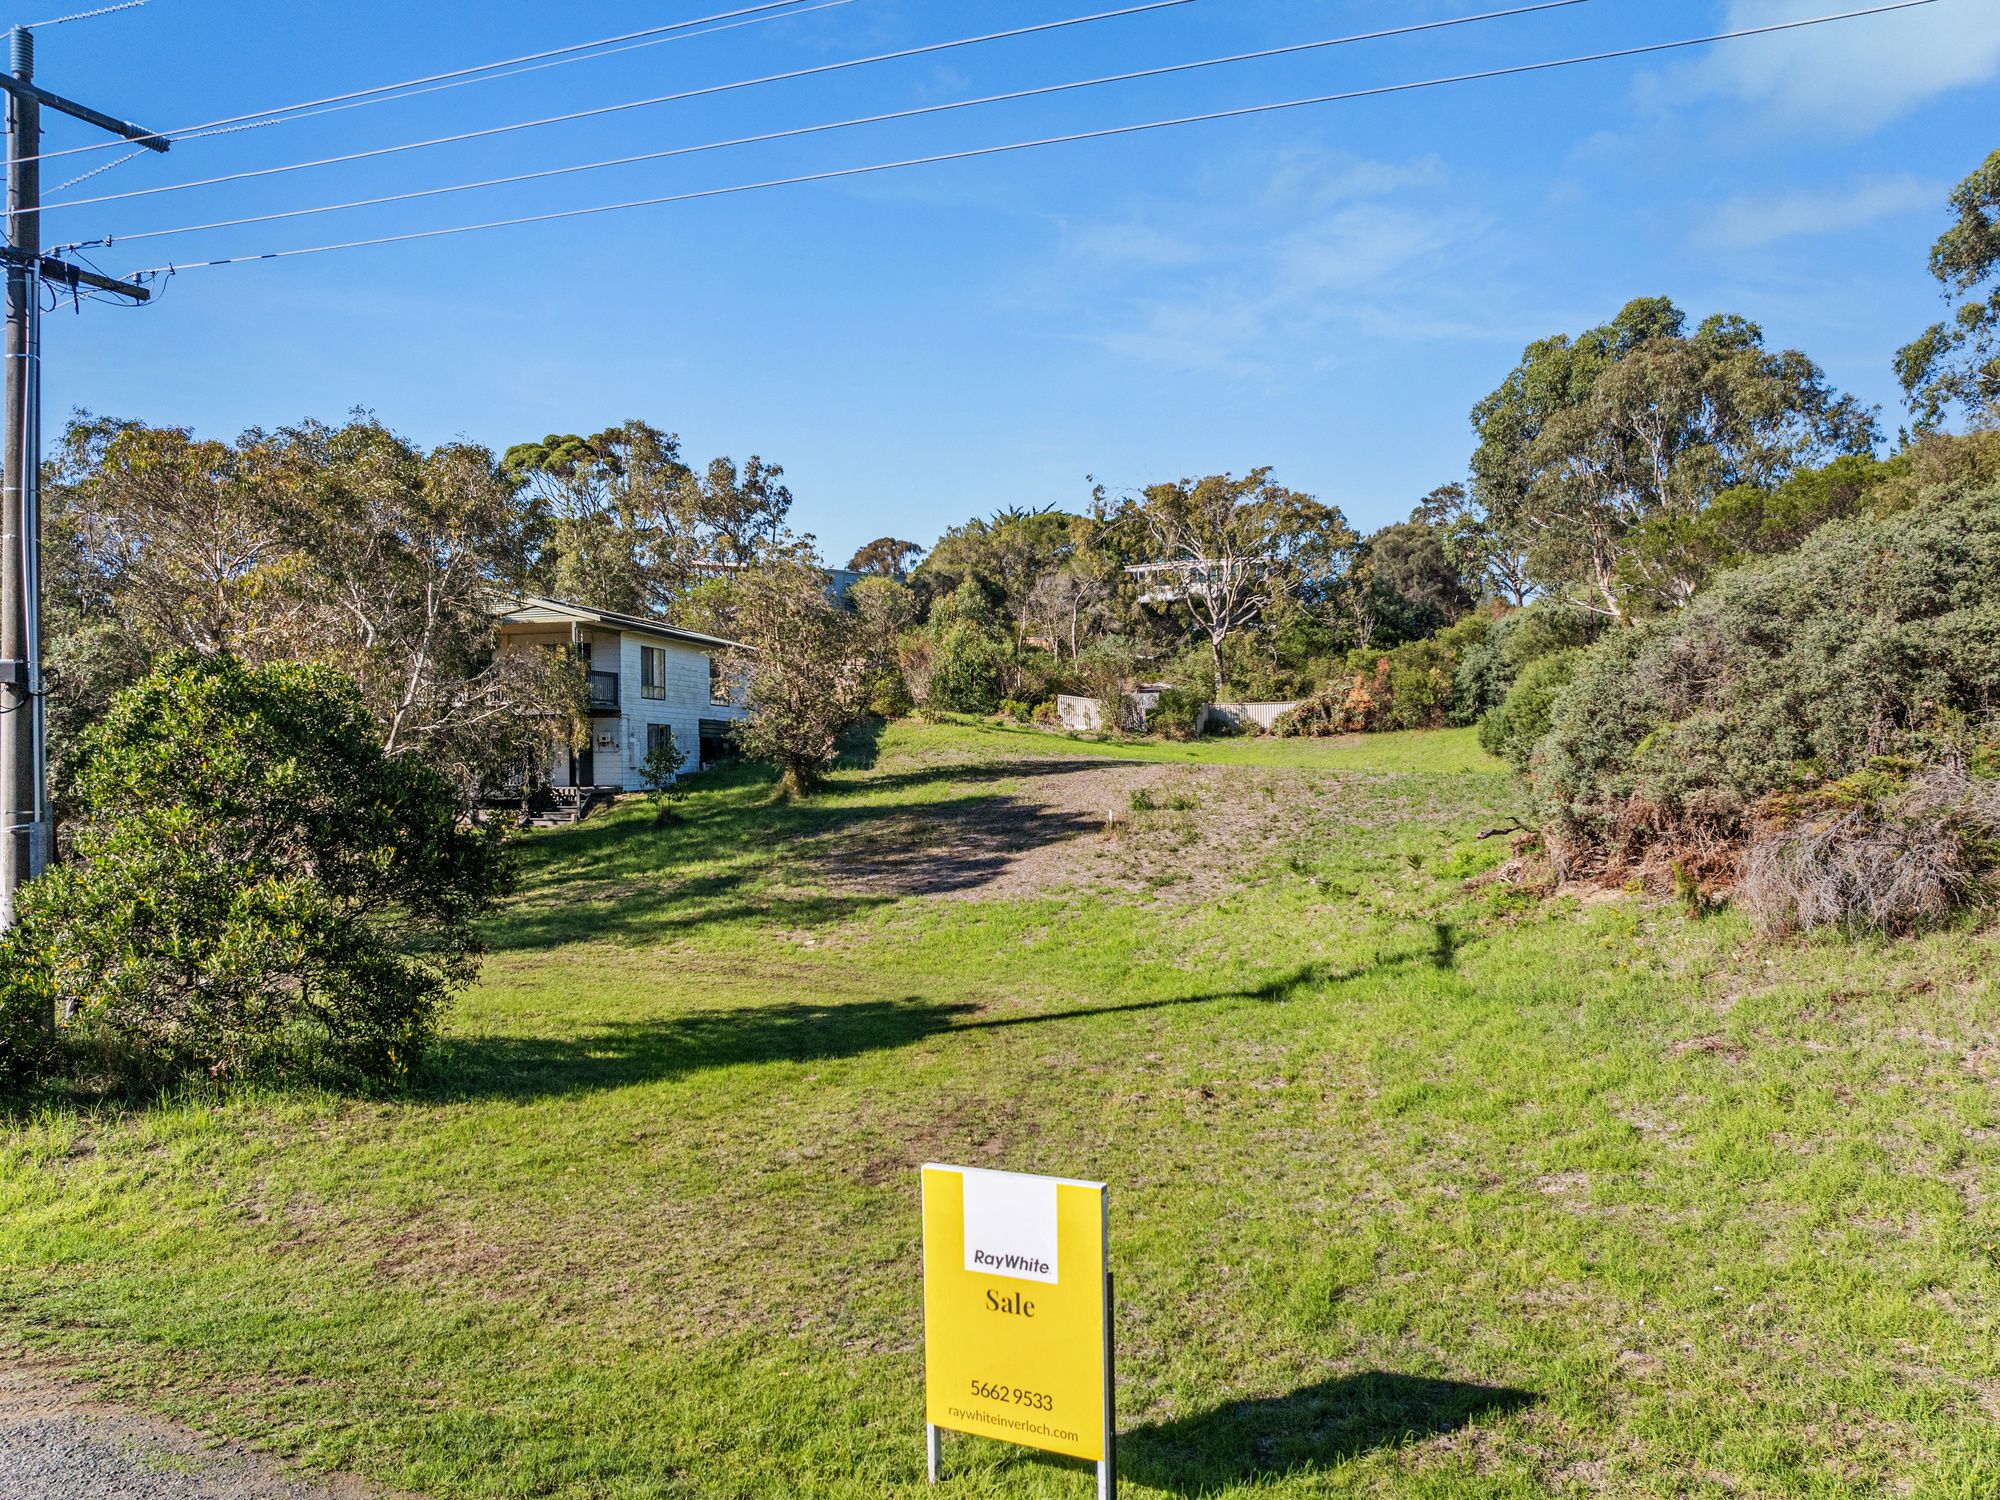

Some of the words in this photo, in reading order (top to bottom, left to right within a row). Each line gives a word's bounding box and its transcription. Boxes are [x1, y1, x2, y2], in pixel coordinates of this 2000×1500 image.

[974, 1249, 1049, 1274] RayWhite
[986, 1288, 1035, 1318] Sale
[971, 1380, 1010, 1403] 5662
[1013, 1388, 1053, 1411] 9533
[948, 1407, 1079, 1442] raywhiteinverloch.com
